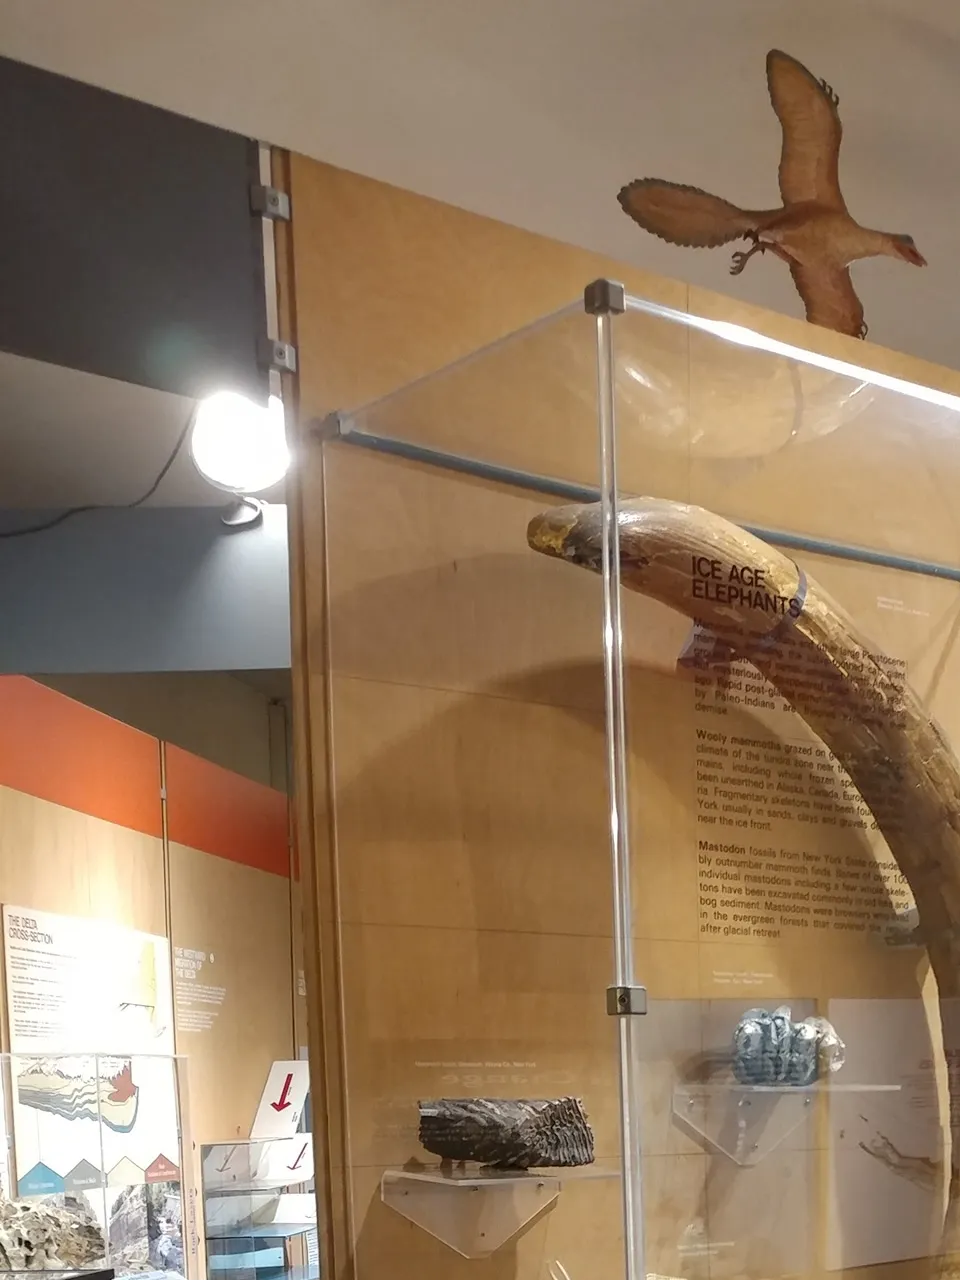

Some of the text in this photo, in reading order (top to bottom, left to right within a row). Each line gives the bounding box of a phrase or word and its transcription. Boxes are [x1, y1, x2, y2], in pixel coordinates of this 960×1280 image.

[692, 556, 766, 589] ICE AGE
[692, 579, 801, 618] ELEPHANTS
[715, 690, 776, 710] Paleo-Indians
[696, 729, 727, 745] Wooly
[784, 744, 812, 756] grazed
[815, 748, 826, 757] on
[696, 744, 728, 757] climate
[732, 749, 742, 759] of
[746, 751, 760, 762] the
[816, 763, 834, 773] near
[732, 762, 771, 779] including
[697, 771, 718, 783] been
[721, 776, 764, 790] unearthed
[697, 798, 718, 810] York
[714, 786, 768, 804] Fragmentary
[697, 814, 717, 825] near
[719, 815, 734, 826] the
[698, 840, 746, 855] Mastodon
[749, 846, 777, 859] fossils
[780, 849, 800, 860] from
[698, 854, 712, 867] bly
[715, 858, 762, 870] outnumber
[765, 862, 809, 875] mammoth
[698, 869, 741, 881] individual
[744, 874, 792, 887] mastodons
[699, 882, 719, 893] tons
[721, 884, 743, 896] have
[745, 886, 766, 897] been
[767, 889, 810, 903] excavated
[699, 896, 717, 908] bog
[764, 900, 810, 915] Mastodons
[699, 911, 708, 919] in
[713, 911, 728, 921] the
[732, 913, 775, 926] evergreen
[700, 923, 721, 934] after
[723, 925, 750, 936] glacial
